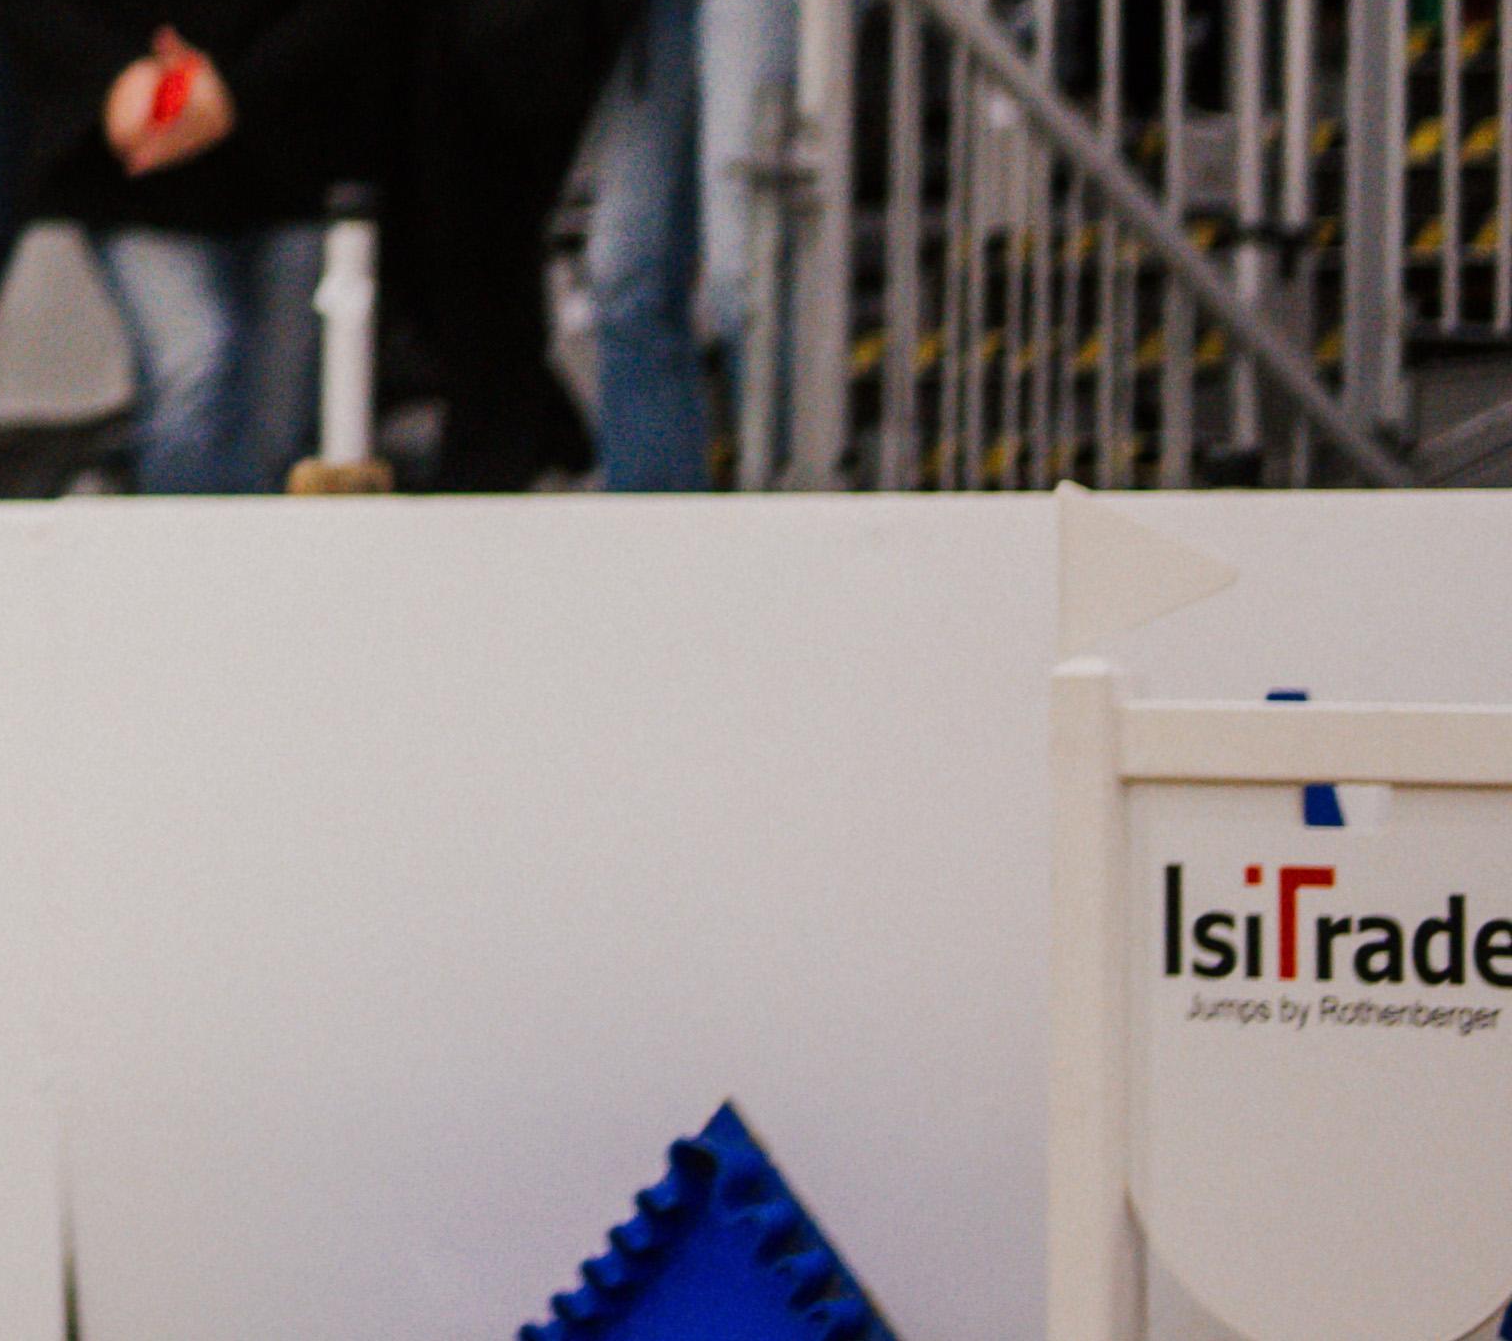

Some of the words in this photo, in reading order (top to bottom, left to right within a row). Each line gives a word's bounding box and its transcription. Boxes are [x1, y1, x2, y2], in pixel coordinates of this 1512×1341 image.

[1165, 863, 1512, 988] IsiTrade
[1187, 994, 1271, 1025] Jumps
[1279, 995, 1311, 1030] by
[1318, 995, 1502, 1036] Rothenberger
